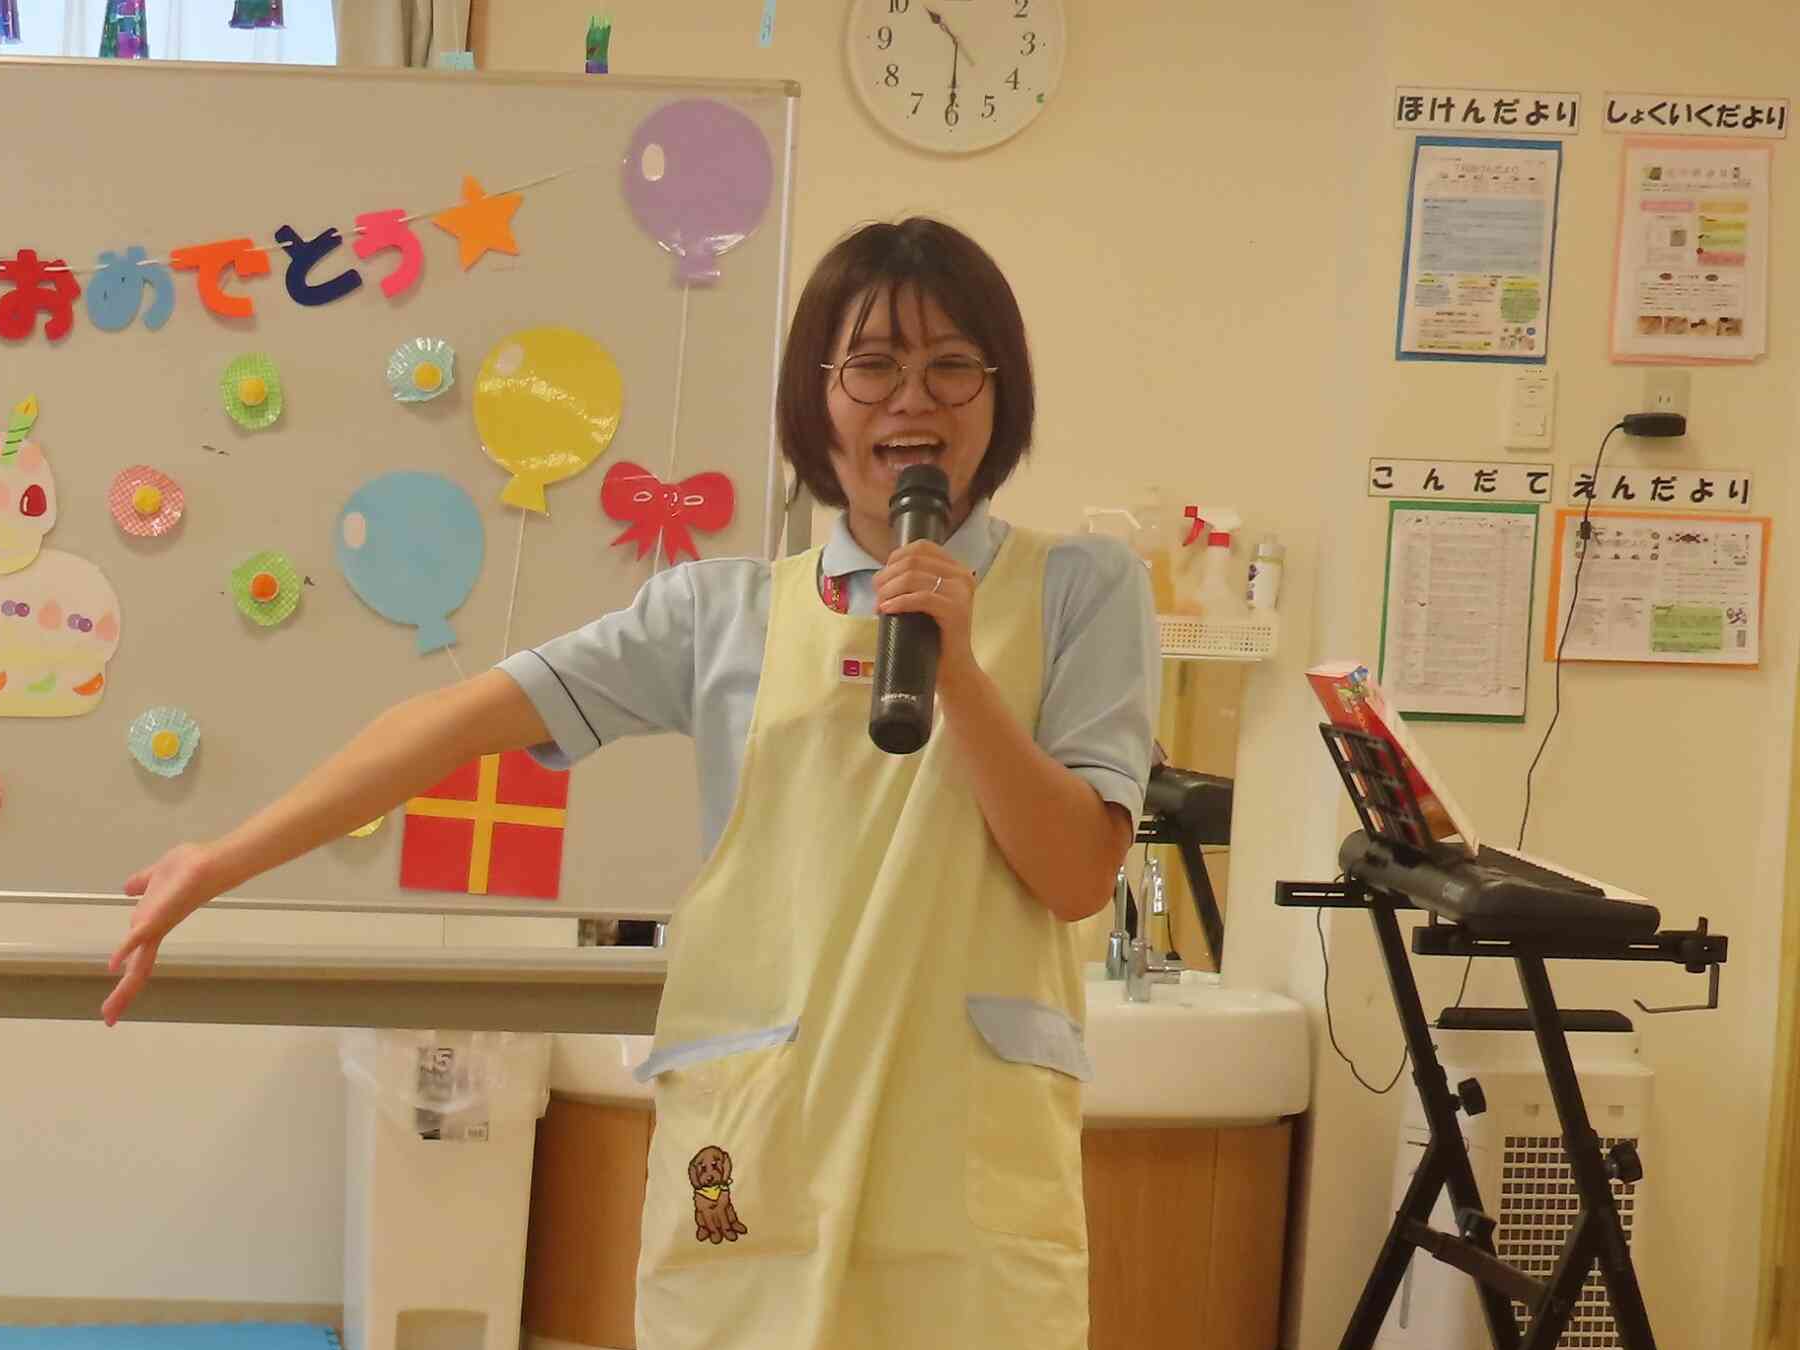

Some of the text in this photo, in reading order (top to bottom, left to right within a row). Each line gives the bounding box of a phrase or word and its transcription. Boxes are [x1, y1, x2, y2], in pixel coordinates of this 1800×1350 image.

[1013, 0, 1029, 18] 2
[877, 26, 893, 50] 9
[1020, 31, 1036, 56] 3
[884, 64, 900, 88] 8
[1004, 67, 1020, 91] 4
[910, 92, 924, 116] 7
[944, 103, 960, 127] 6
[981, 95, 996, 119] 5
[1396, 95, 1577, 128] ほけんだより
[1606, 99, 1786, 131] しょくいくだより
[1371, 465, 1550, 495] こんだて
[1571, 473, 1750, 505] えんだより
